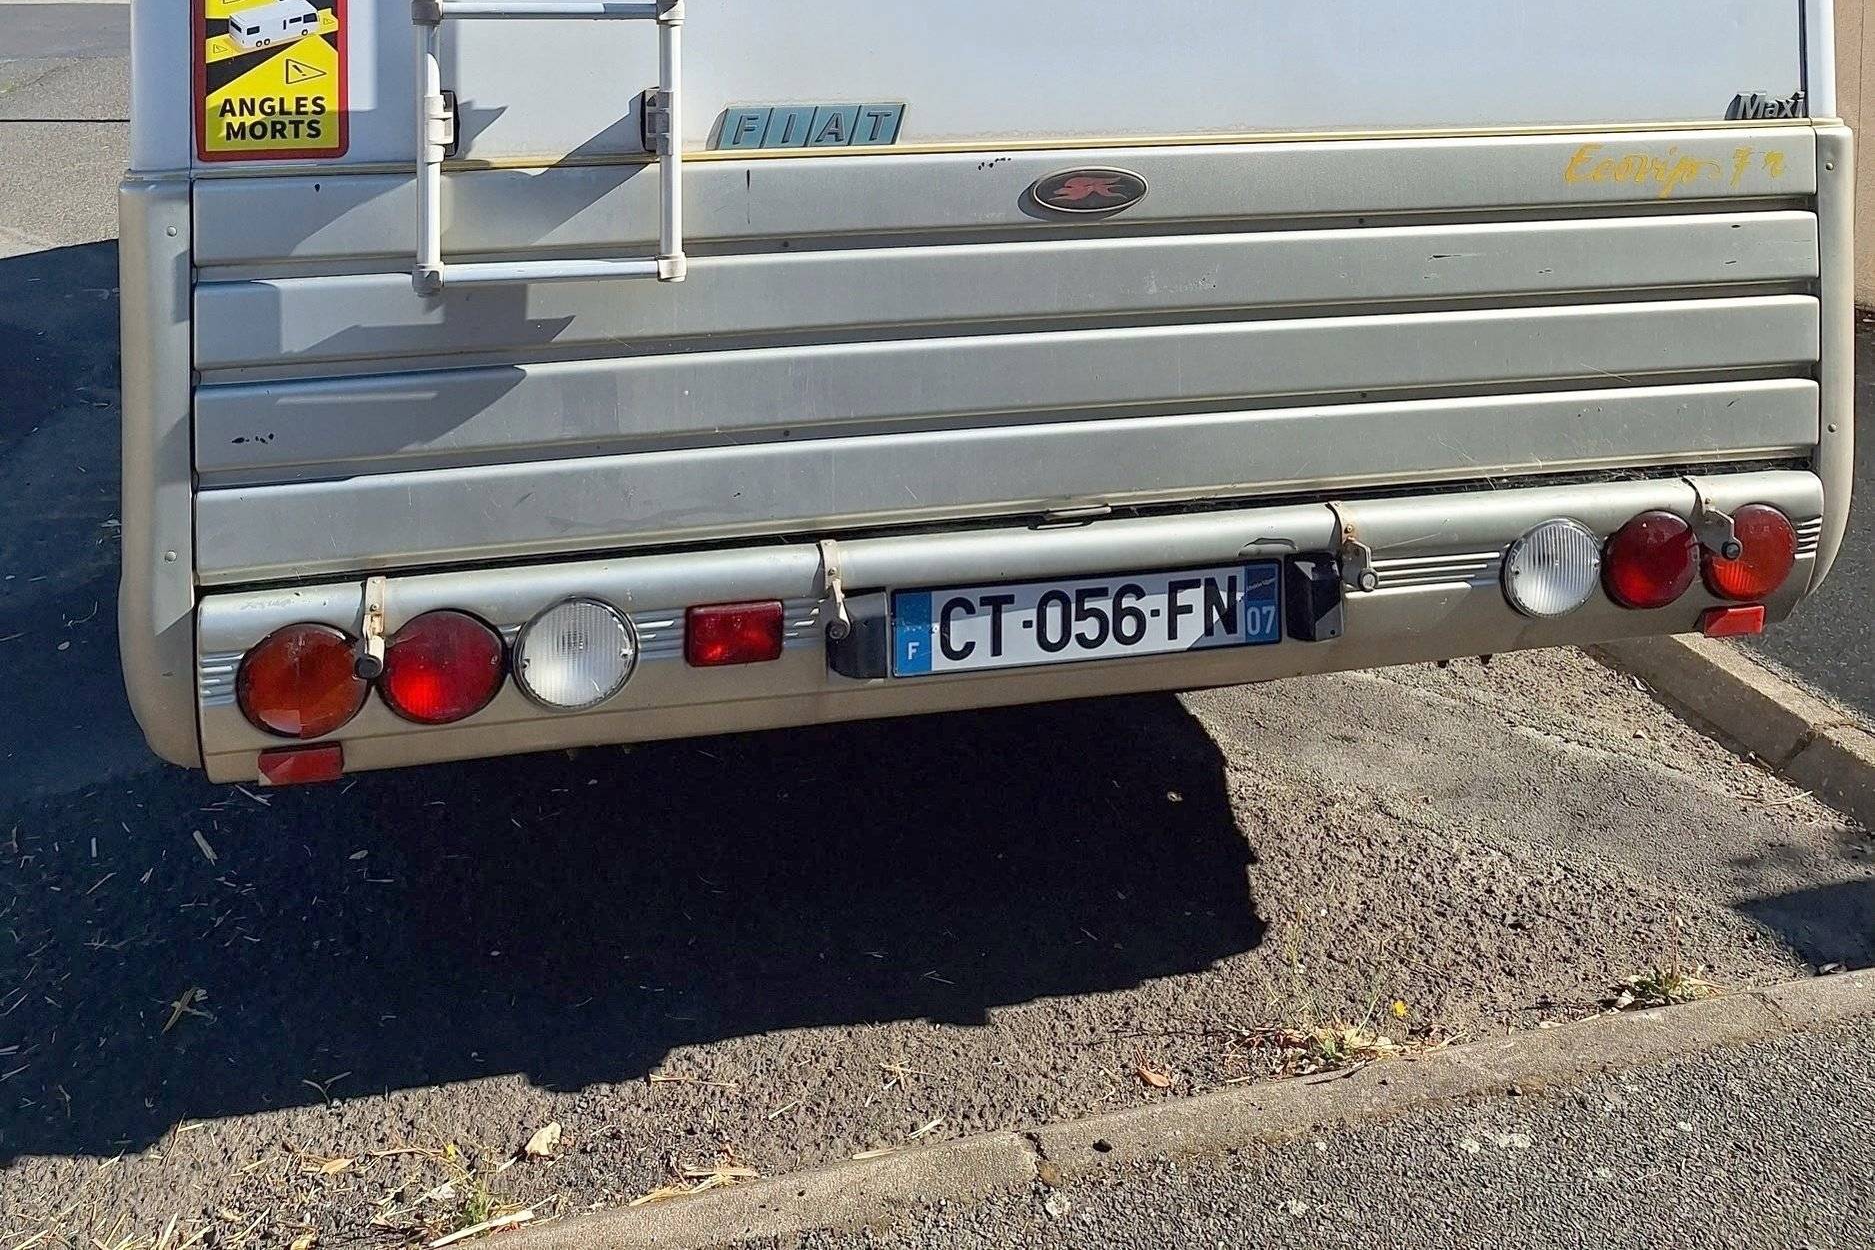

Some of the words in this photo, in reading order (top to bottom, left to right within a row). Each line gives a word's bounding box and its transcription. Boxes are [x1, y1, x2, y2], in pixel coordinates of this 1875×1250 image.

[218, 95, 327, 118] ANGLES
[1736, 91, 1805, 120] Maxi
[225, 118, 323, 141] MORTS
[732, 110, 892, 145] FIAT
[907, 641, 920, 660] F
[940, 575, 1238, 662] CT-056-FN
[1246, 605, 1276, 636] 07
